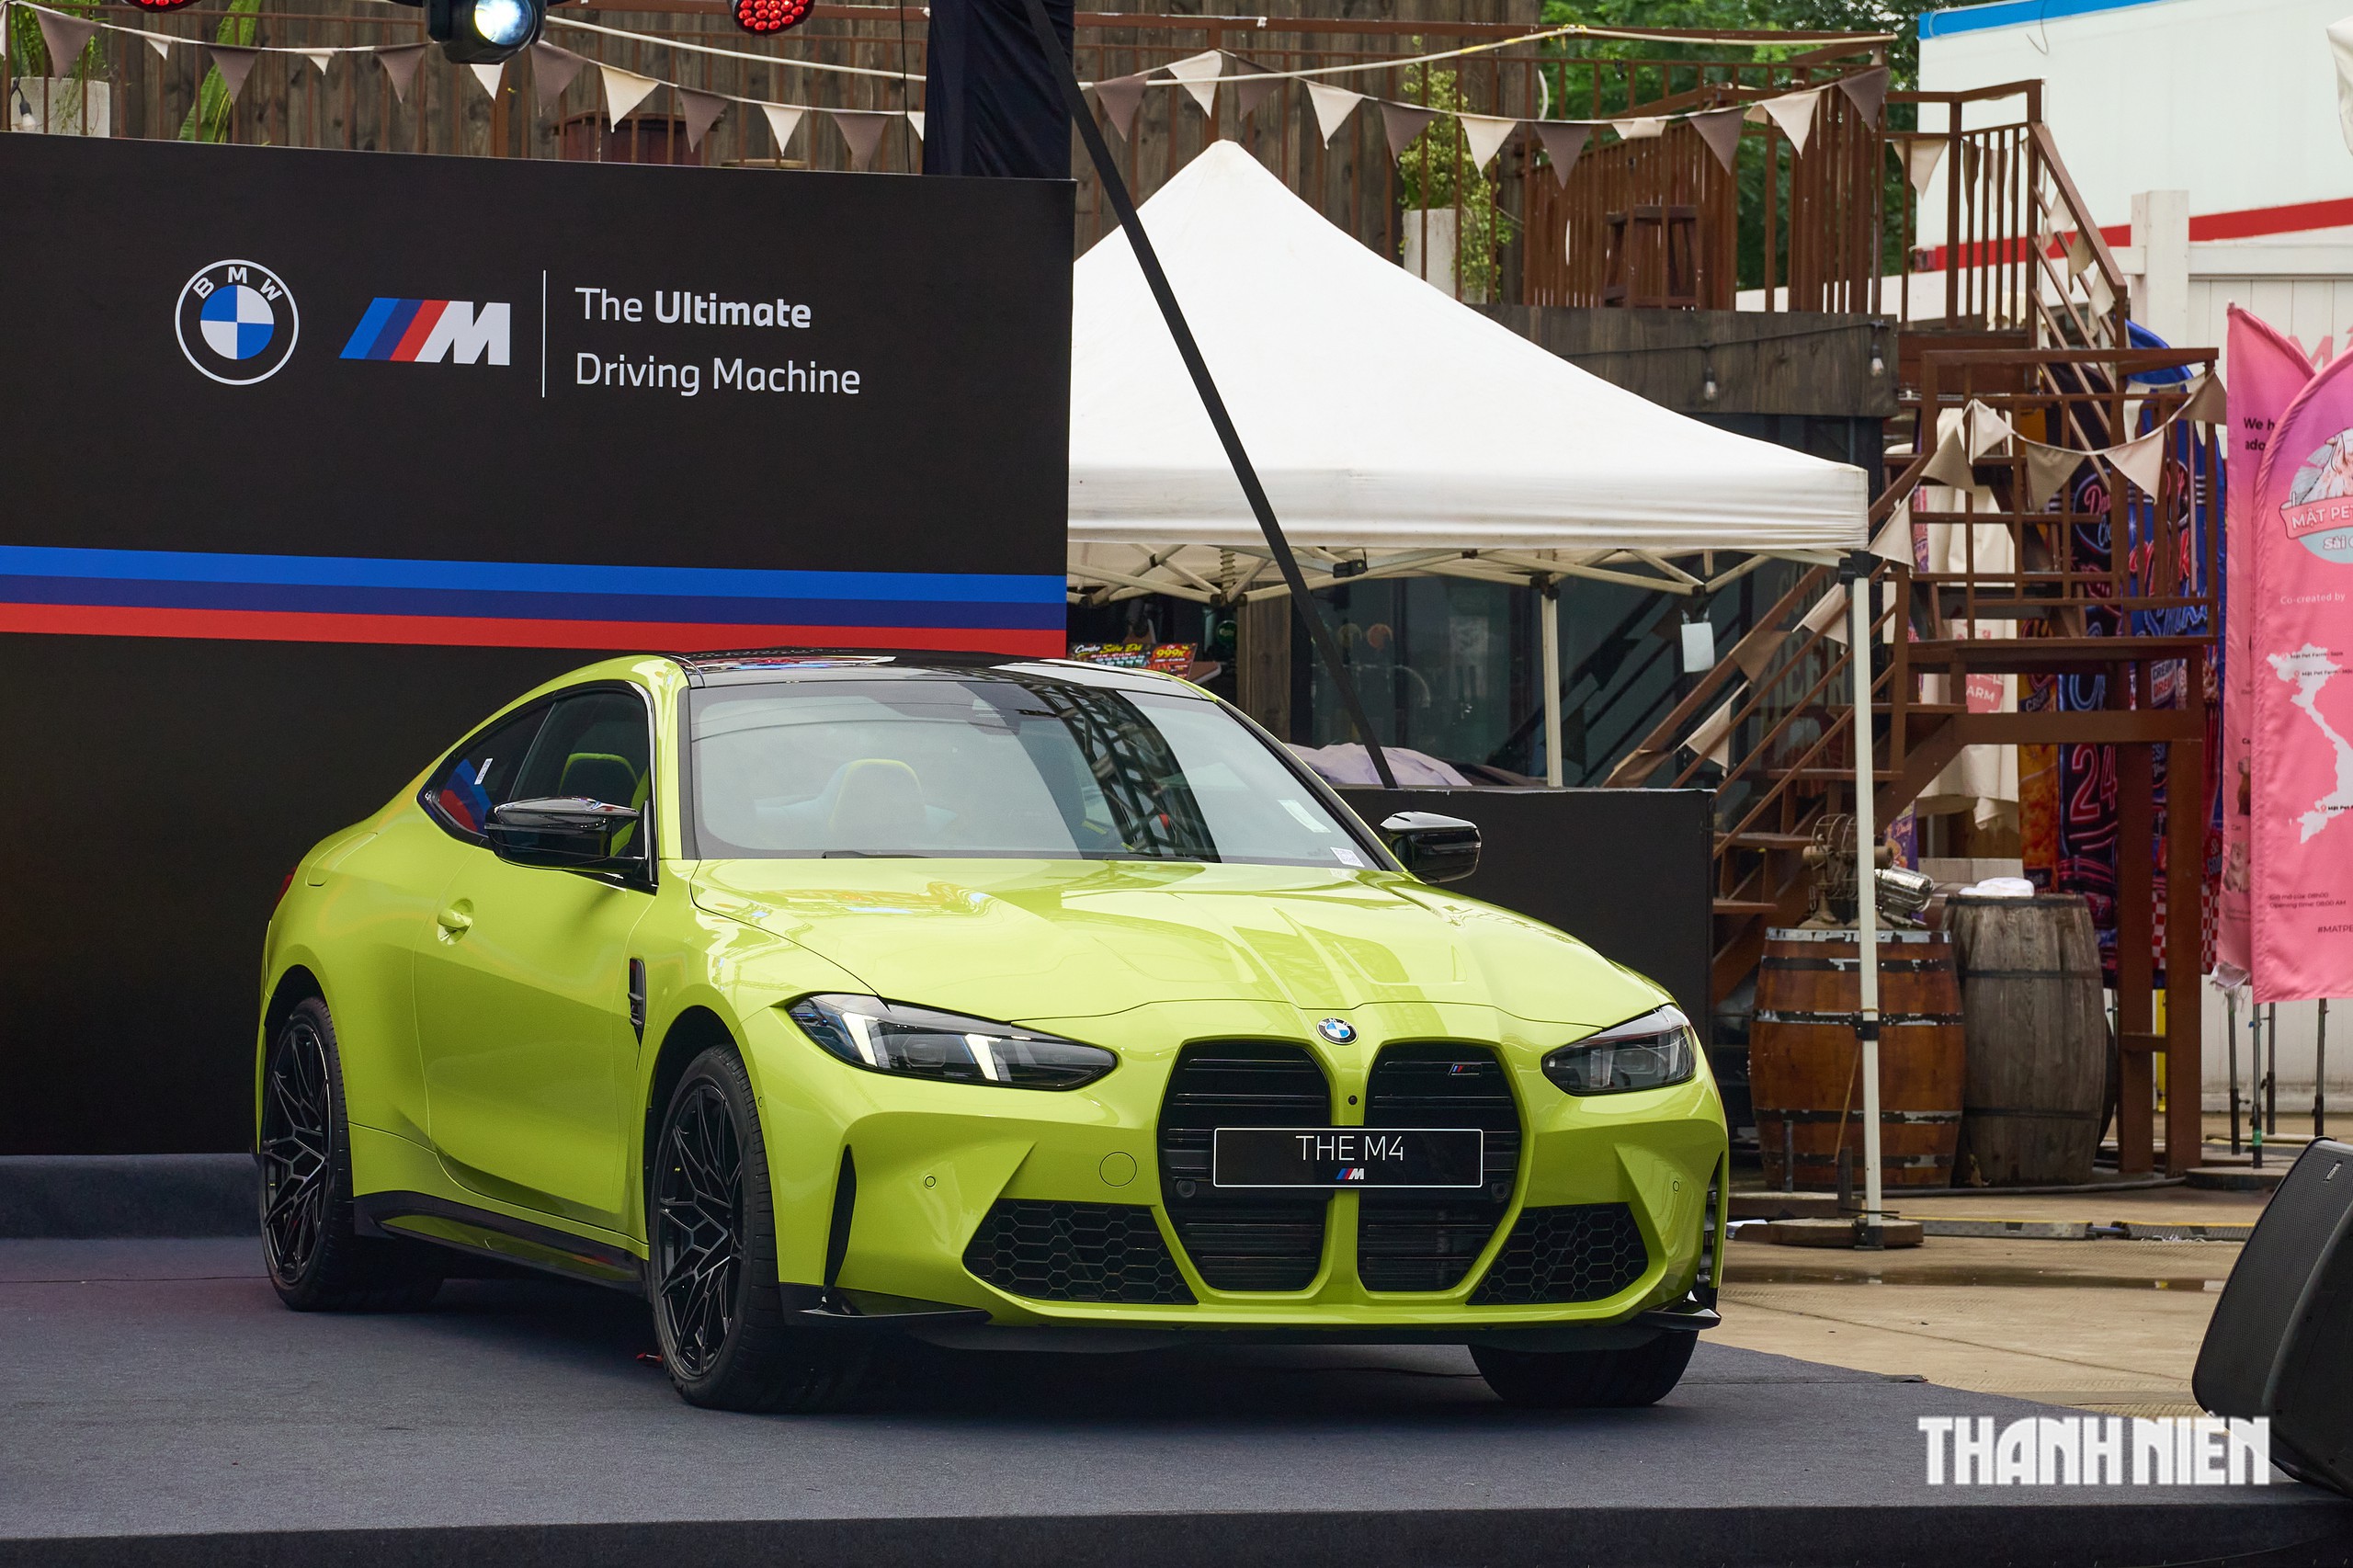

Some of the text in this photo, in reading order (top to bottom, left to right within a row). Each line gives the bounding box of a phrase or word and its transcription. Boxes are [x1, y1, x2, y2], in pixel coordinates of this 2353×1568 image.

[192, 267, 282, 301] BMW
[574, 287, 812, 329] The Ultimate
[576, 352, 861, 397] Driving Machine
[2244, 417, 2263, 430] We
[2335, 591, 2346, 602] by
[1966, 685, 1995, 703] ARM
[2070, 743, 2118, 823] 24
[1295, 1134, 1404, 1161] THE M4
